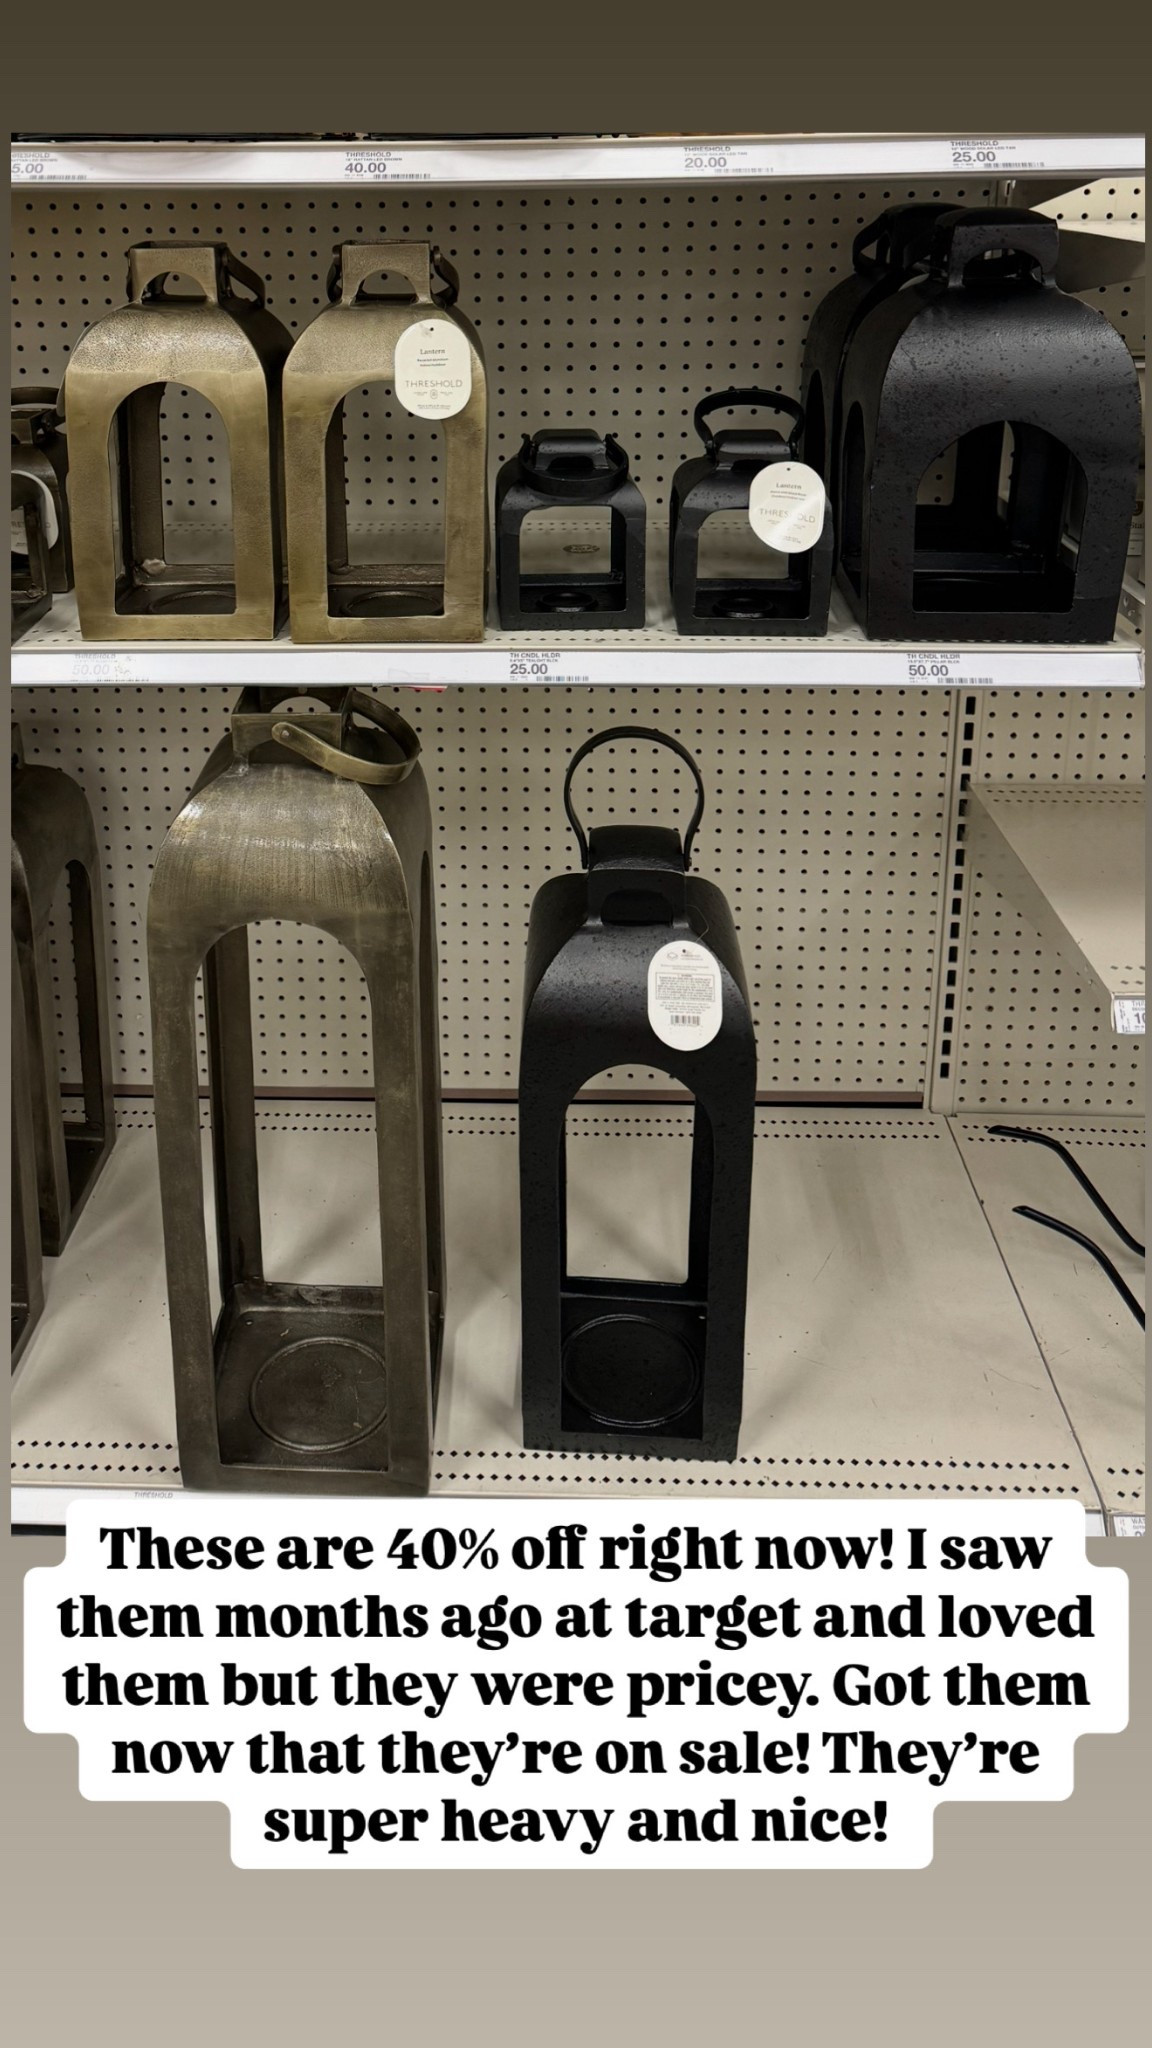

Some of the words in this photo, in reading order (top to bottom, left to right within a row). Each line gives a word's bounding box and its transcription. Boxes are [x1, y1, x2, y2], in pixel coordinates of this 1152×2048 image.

[951, 151, 996, 162] 25.00
[345, 162, 387, 173] 40.00
[684, 157, 727, 168] 20.00
[404, 379, 463, 388] THRESHOLD
[776, 482, 802, 490] Lantern
[759, 508, 816, 523] THRESOLD
[510, 663, 548, 675] 25.00
[908, 665, 949, 676] 50.00
